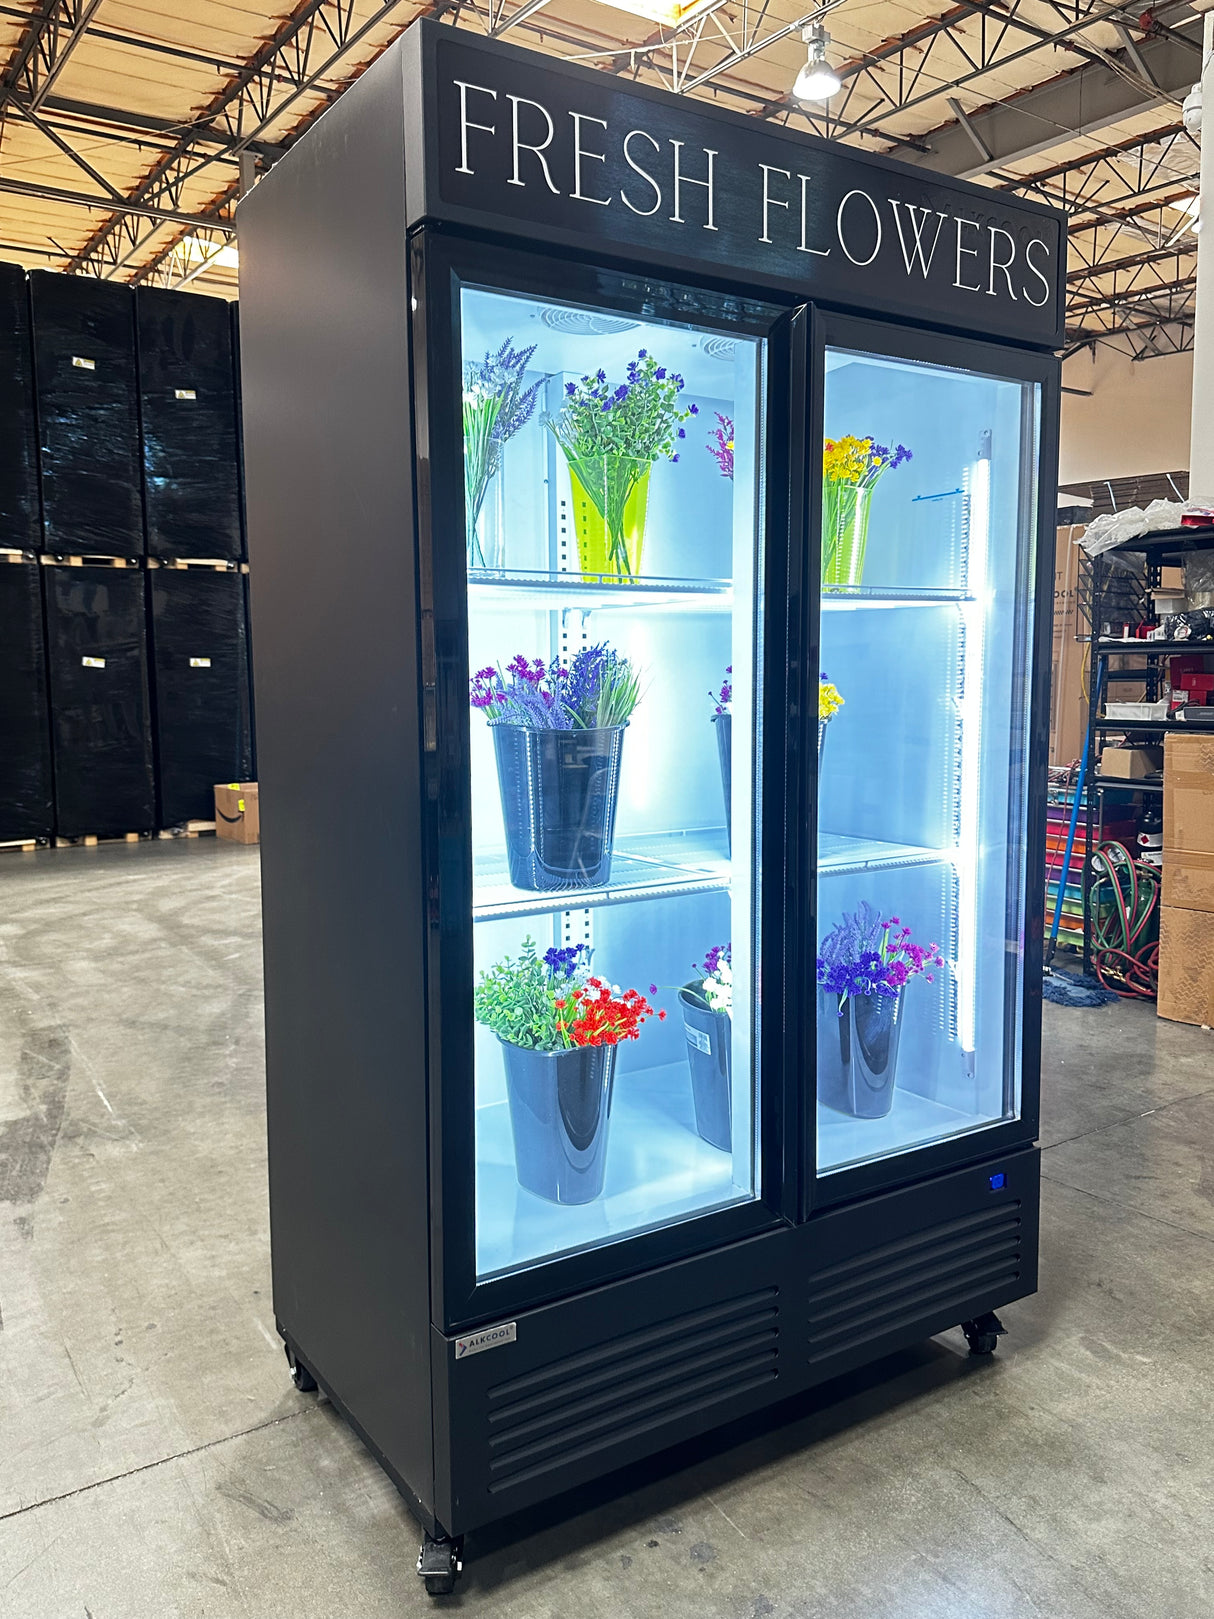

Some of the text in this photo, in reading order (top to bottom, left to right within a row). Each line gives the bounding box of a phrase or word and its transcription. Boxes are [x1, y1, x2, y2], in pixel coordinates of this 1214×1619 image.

[453, 79, 1051, 308] FRESH FLOWERS
[469, 1329, 510, 1347] ALKCOOL
